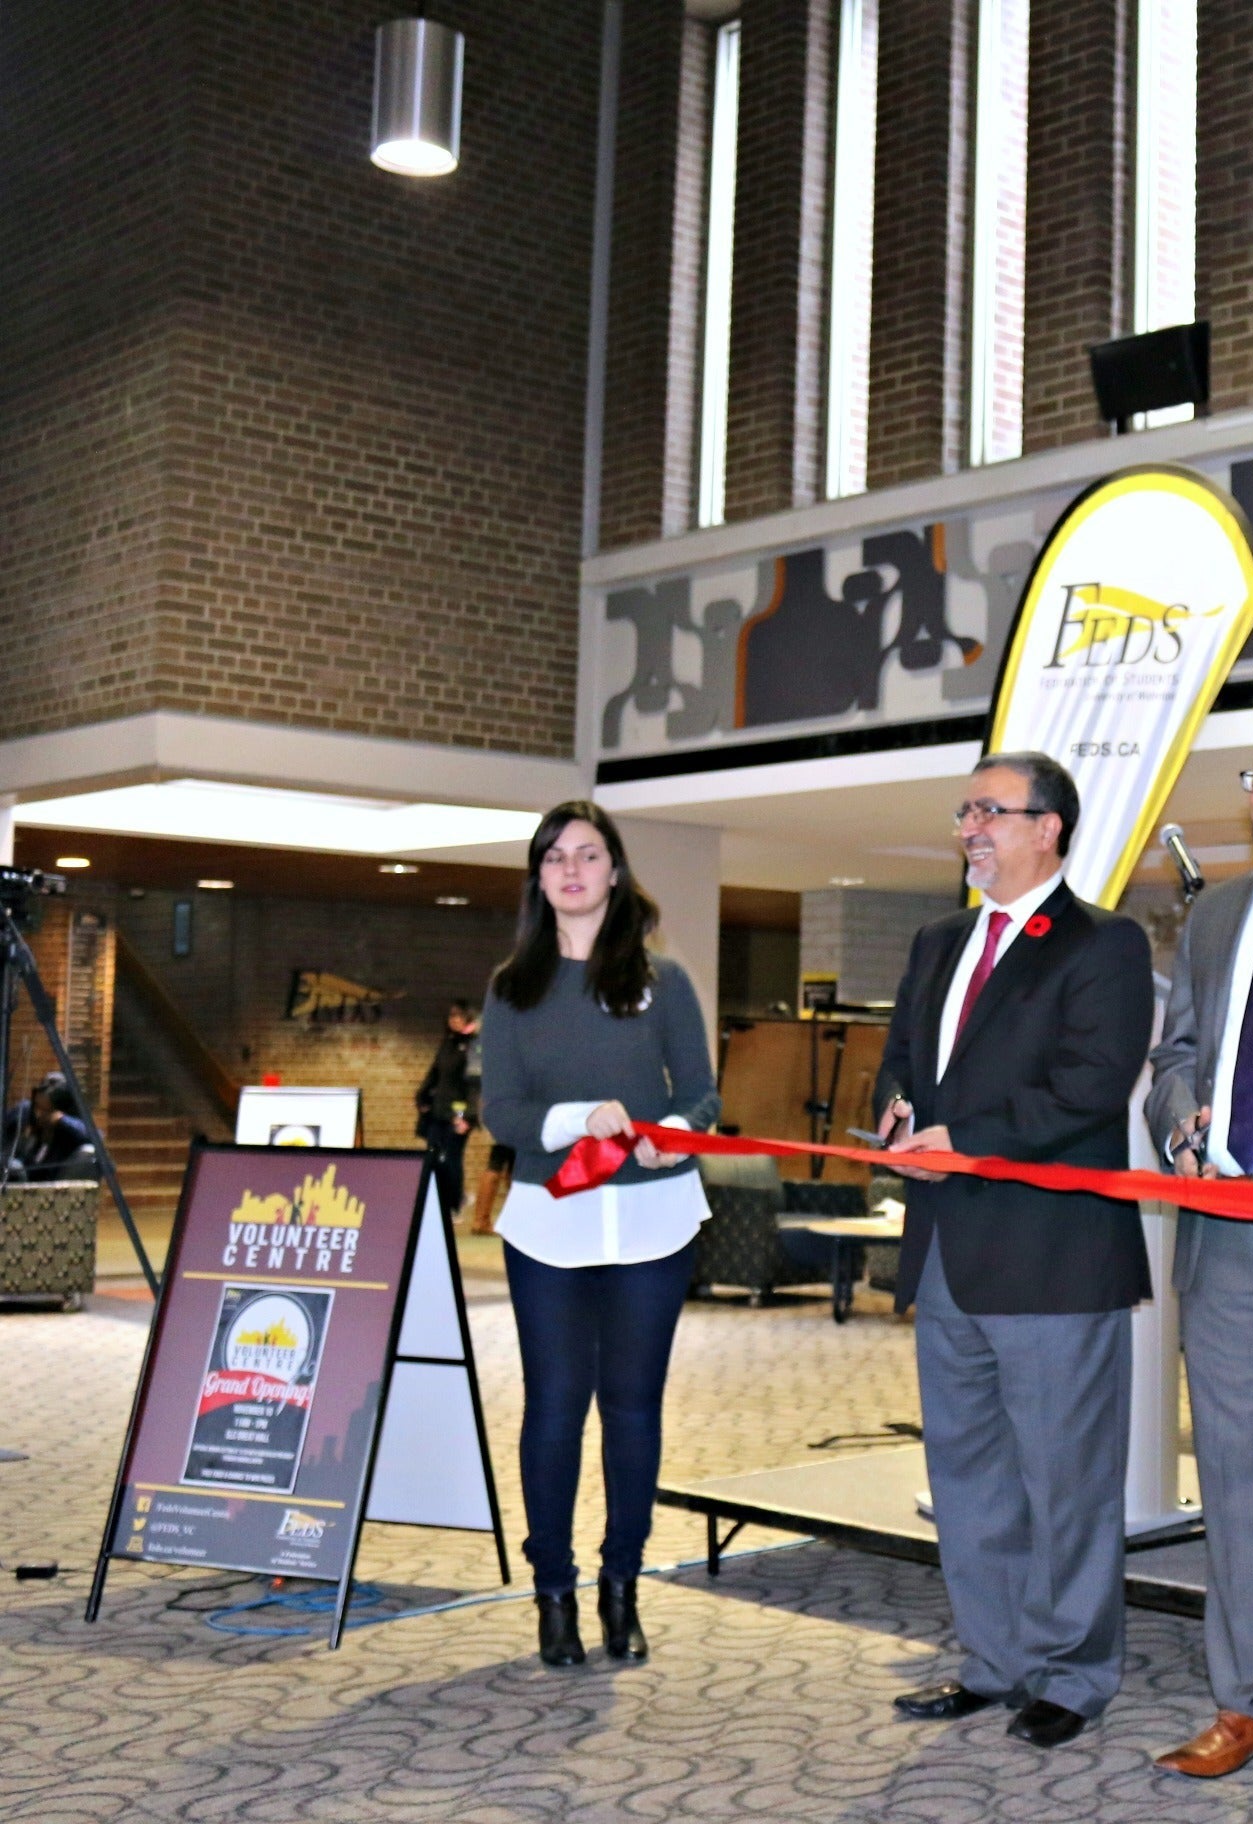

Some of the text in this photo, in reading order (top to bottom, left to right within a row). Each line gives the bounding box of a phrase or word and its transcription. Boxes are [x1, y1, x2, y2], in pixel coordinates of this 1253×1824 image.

[1043, 583, 1189, 669] FEDS
[1070, 741, 1141, 757] FEDS.CA
[229, 1222, 359, 1250] VOLUNTEER
[222, 1244, 357, 1273] CENTRE
[231, 1356, 295, 1370] CENTRE
[233, 1345, 297, 1360] VOLUNTEER
[203, 1371, 251, 1398] Grand
